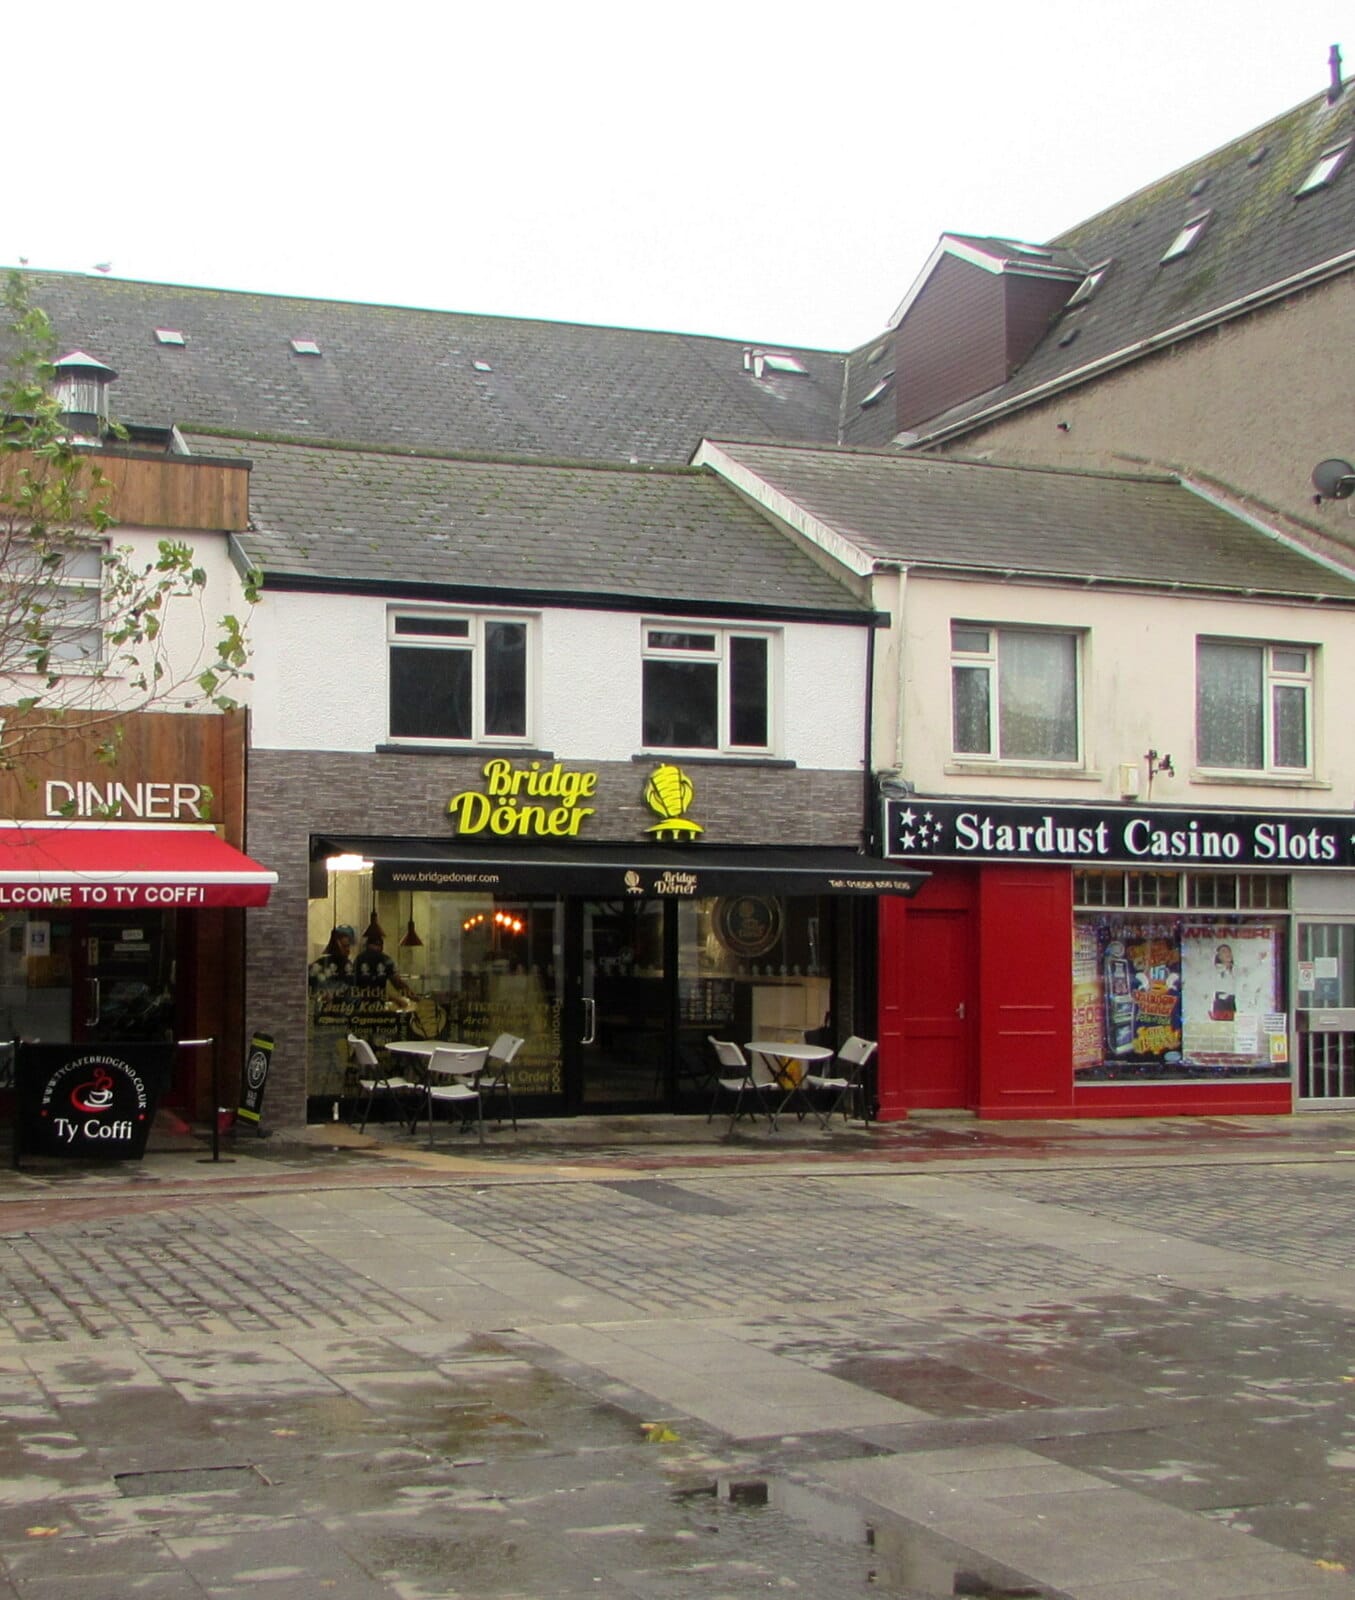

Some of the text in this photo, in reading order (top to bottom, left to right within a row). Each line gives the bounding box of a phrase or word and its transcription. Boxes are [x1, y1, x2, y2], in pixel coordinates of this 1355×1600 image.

[45, 780, 202, 819] DINNER
[483, 757, 598, 809] Bridge
[449, 795, 594, 837] Döner
[955, 812, 1337, 861] Stardust Casino Slots
[79, 886, 108, 904] TO
[113, 886, 139, 904] TY
[145, 887, 205, 904] COFFI
[391, 872, 500, 885] www.bridgedoner.com
[662, 871, 697, 887] Bridge
[53, 1117, 133, 1144] Ty Coffi
